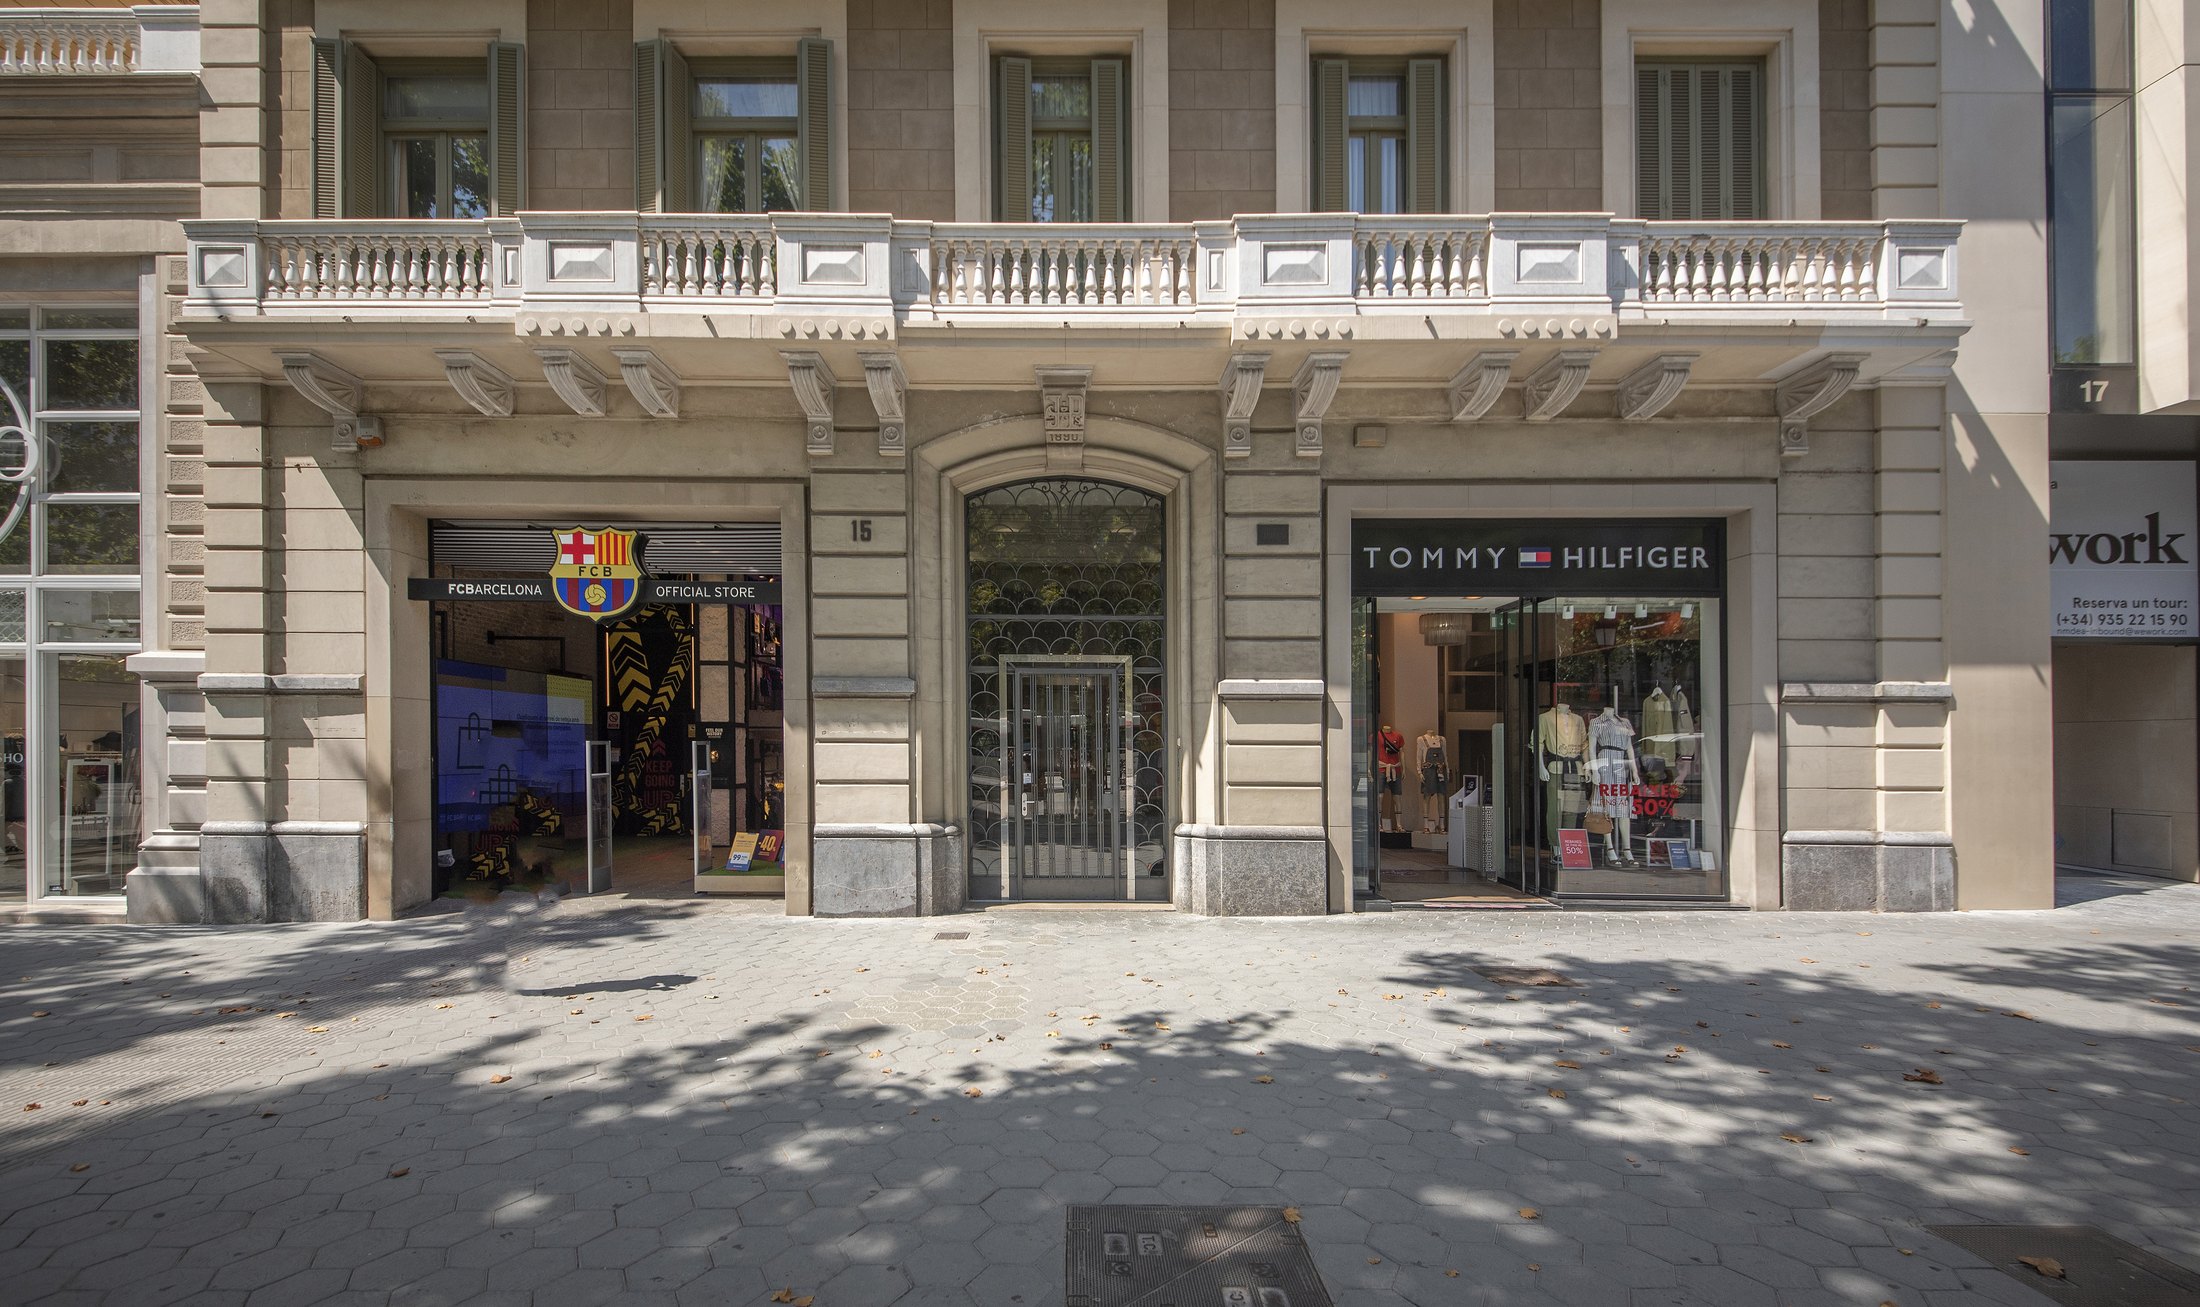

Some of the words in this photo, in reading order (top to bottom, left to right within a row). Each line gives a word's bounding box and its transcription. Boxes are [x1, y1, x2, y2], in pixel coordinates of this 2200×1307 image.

[2079, 380, 2109, 403] 17
[851, 519, 872, 542] 15
[1363, 546, 1506, 569] TOMMY
[1562, 546, 1710, 569] HILFIGER
[578, 566, 613, 577] FCB
[448, 583, 543, 596] FCBARCELONA
[655, 586, 711, 598] OFFICIAL
[714, 586, 755, 598] STORE
[2073, 597, 2128, 609] Reserva
[2132, 599, 2149, 609] un
[2153, 597, 2188, 609] tour:
[2056, 613, 2093, 627] (+34)
[2097, 613, 2124, 626] 935
[2128, 613, 2146, 626] 22
[2150, 613, 2166, 626] 15
[2170, 613, 2188, 626] 90
[646, 760, 673, 773] KEEP
[645, 774, 676, 788] GOING
[1599, 783, 1681, 799] REBAIXES
[643, 790, 676, 810] UP
[1631, 799, 1678, 817] 50%
[1566, 846, 1584, 855] 50%
